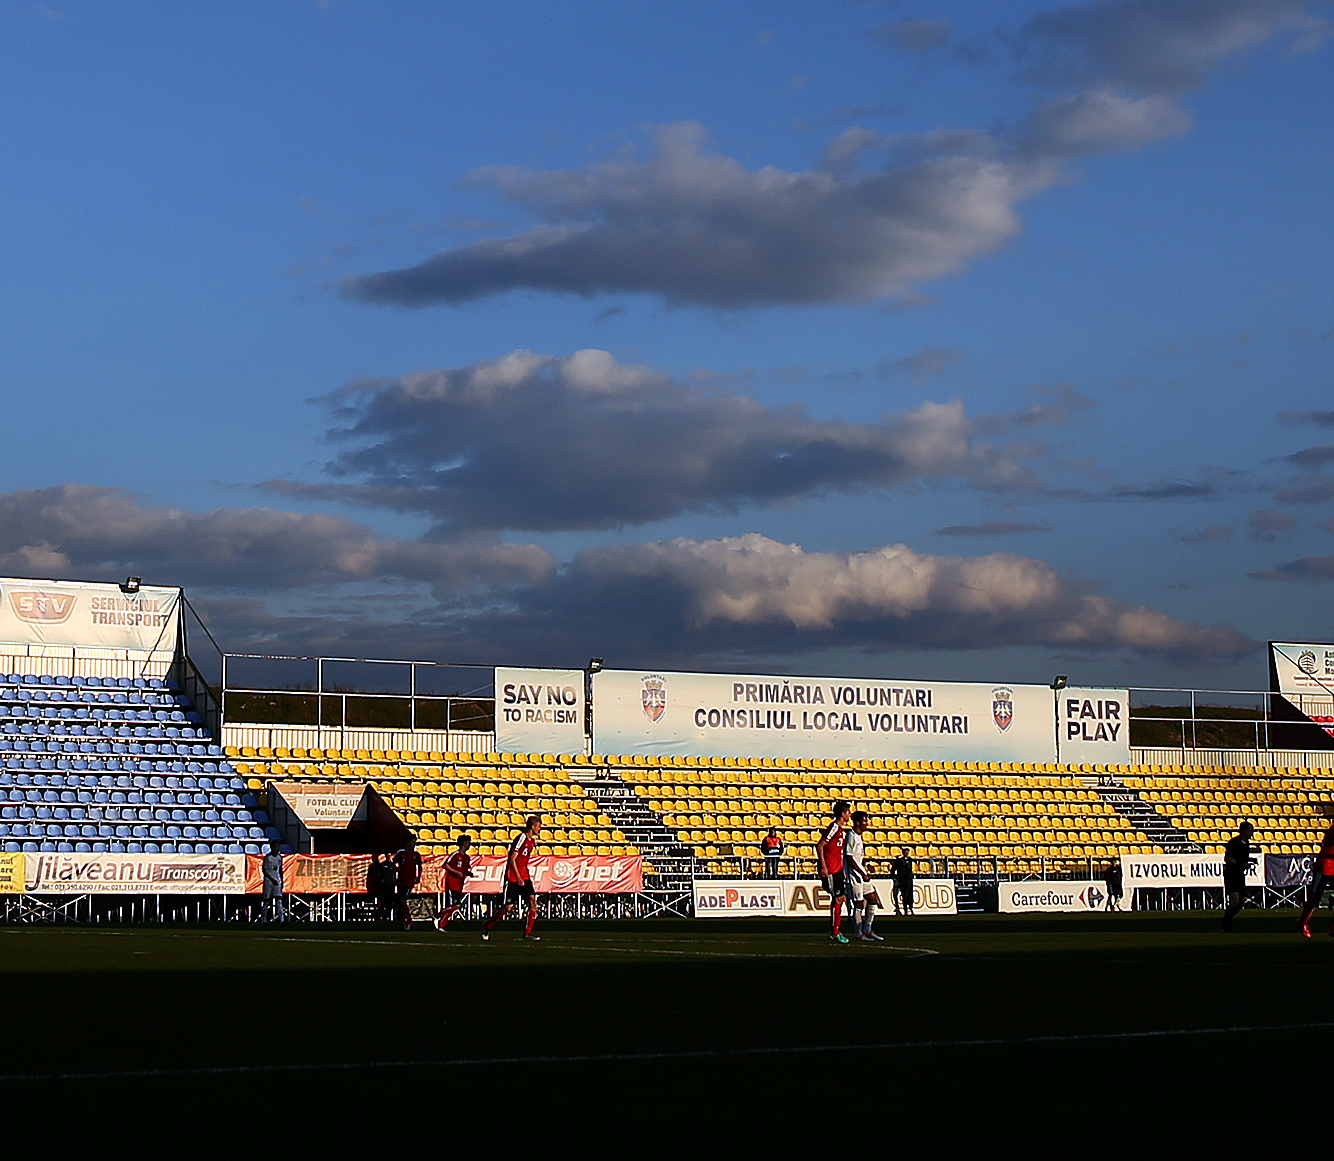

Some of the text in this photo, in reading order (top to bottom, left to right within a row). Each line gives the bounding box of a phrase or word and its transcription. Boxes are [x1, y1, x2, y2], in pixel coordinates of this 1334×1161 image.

[91, 596, 160, 613] SERVICIUL
[91, 612, 169, 628] TRANSPORT
[503, 683, 577, 706] SAY NO
[733, 680, 933, 708] PRIMĂRIA VOLUNTARI
[503, 708, 577, 724] TO RACISM
[1067, 698, 1120, 719] FAIR
[695, 708, 968, 735] CONSILIUL LOCAL VOLUNTARI
[1067, 721, 1121, 742] PLAY
[307, 798, 337, 806] FOTBAL
[315, 808, 352, 816] Voluntari
[25, 855, 221, 891] Jilăveanu Transcom
[578, 860, 624, 882] bet
[1130, 863, 1186, 878] IZVORUL
[698, 888, 777, 908] ADEPLAST
[1011, 890, 1074, 907] Carrefour
